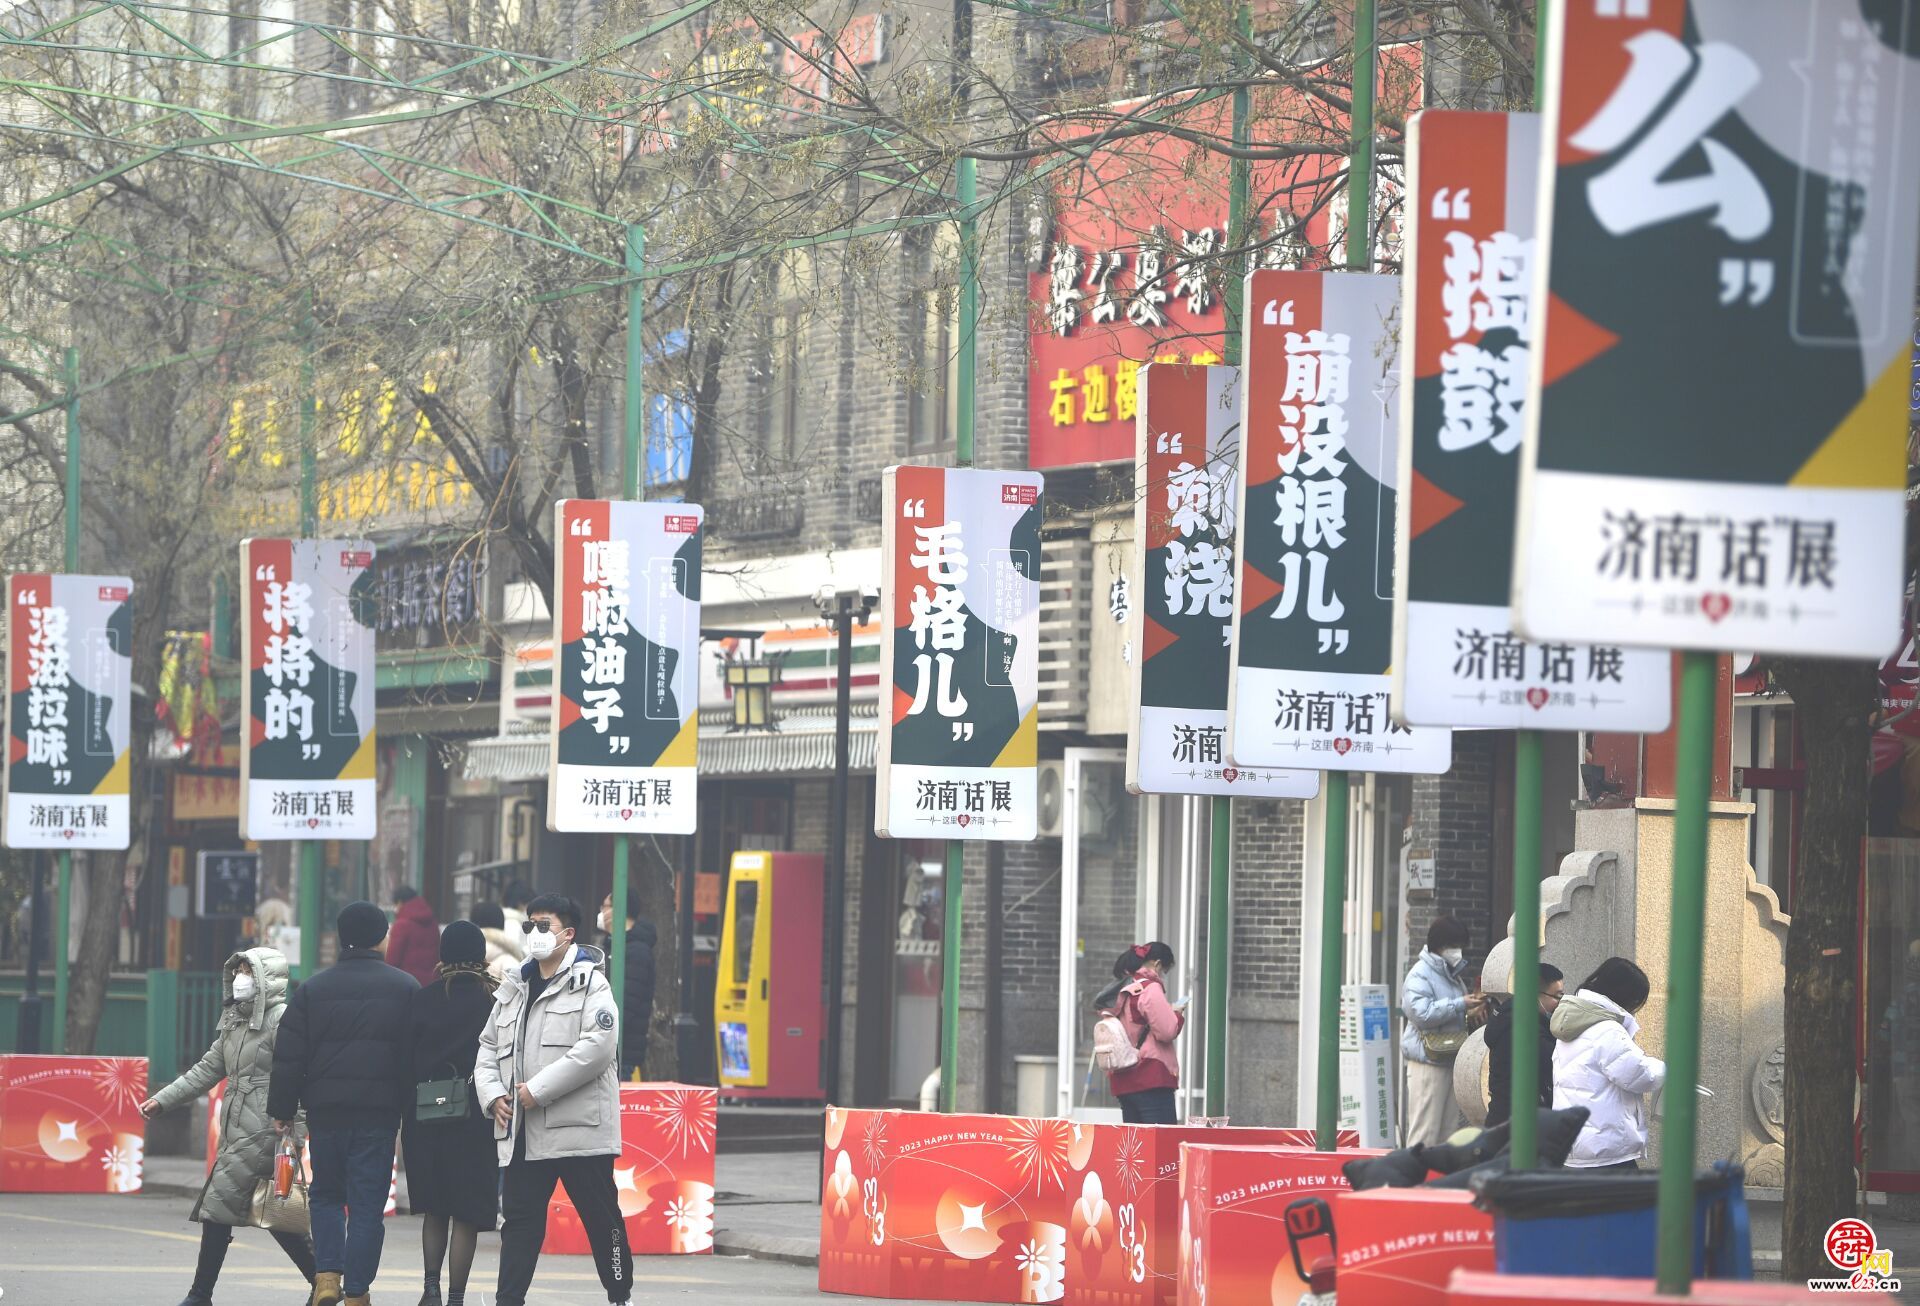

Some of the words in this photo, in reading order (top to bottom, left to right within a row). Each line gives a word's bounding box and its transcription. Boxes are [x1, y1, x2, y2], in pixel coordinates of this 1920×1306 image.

[629, 1103, 651, 1112] YEAR
[900, 1140, 921, 1154] 2023
[924, 1133, 954, 1146] HAPPY
[957, 1132, 977, 1140] NEW
[980, 1132, 1003, 1143] YEAR
[1215, 1188, 1246, 1205] 2023
[1250, 1177, 1292, 1194] HAPPY
[1297, 1175, 1326, 1186] NEW
[1342, 1244, 1380, 1266] 2023
[1384, 1232, 1437, 1253] HAPPY
[1443, 1230, 1479, 1243] NEW
